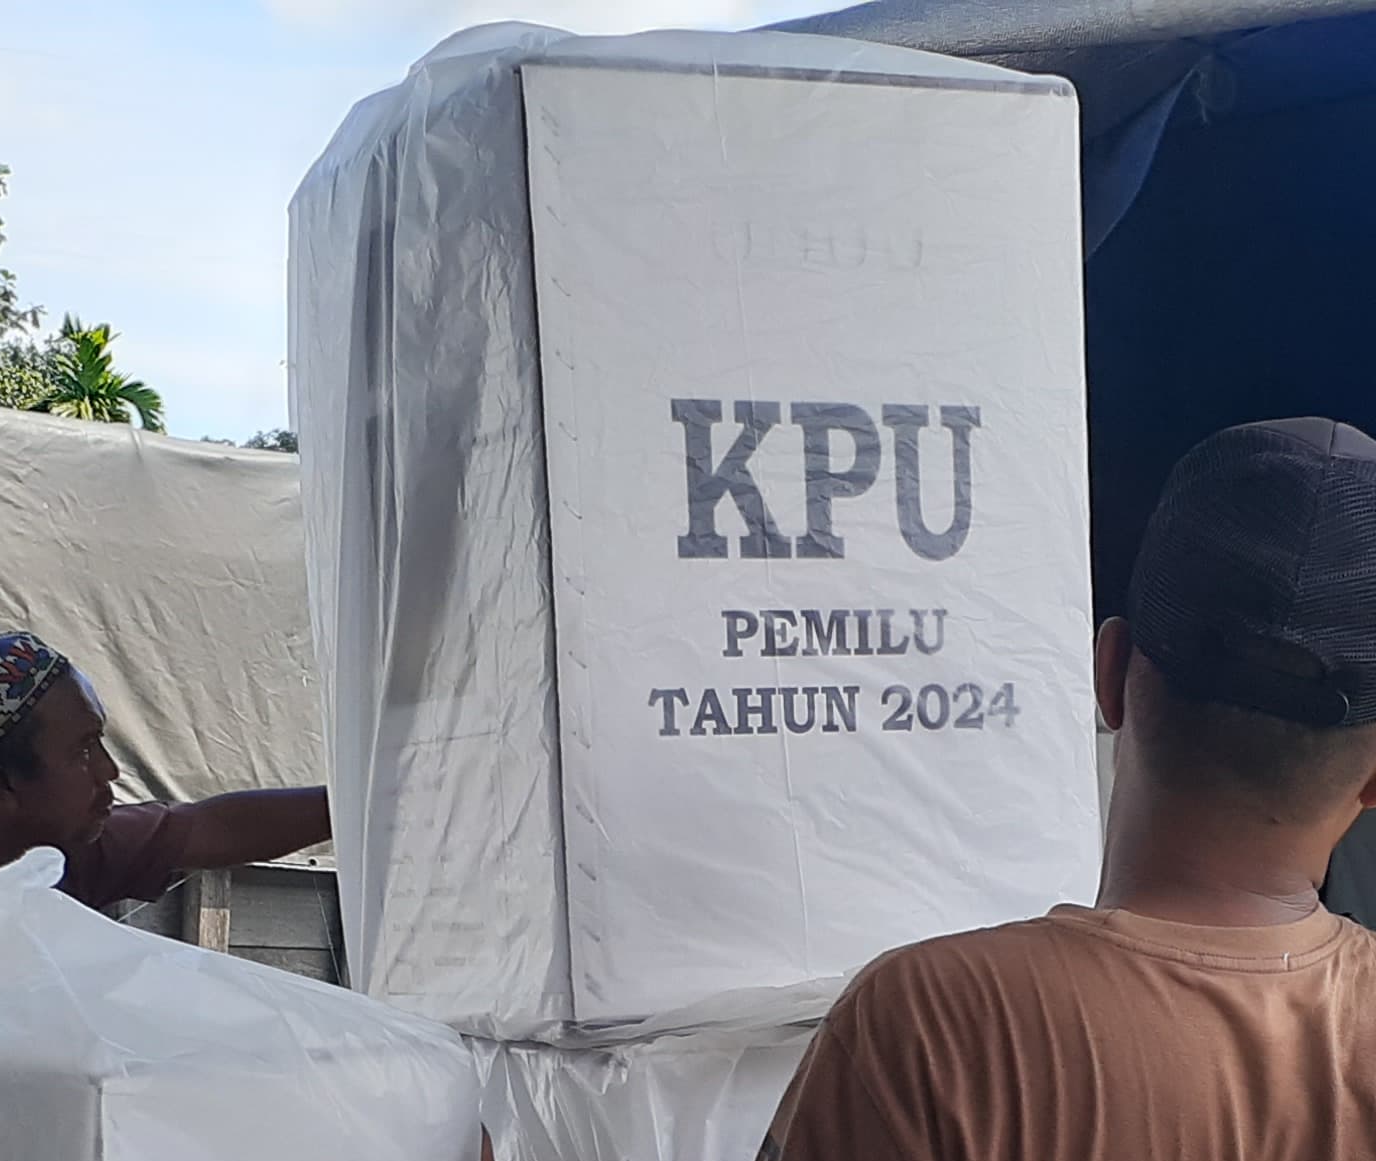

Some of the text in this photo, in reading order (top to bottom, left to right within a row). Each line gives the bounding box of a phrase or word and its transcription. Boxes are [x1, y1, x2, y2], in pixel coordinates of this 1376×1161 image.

[670, 398, 982, 561] KPU
[721, 608, 948, 657] PEMILU
[648, 682, 1022, 736] TAHUN 2024
